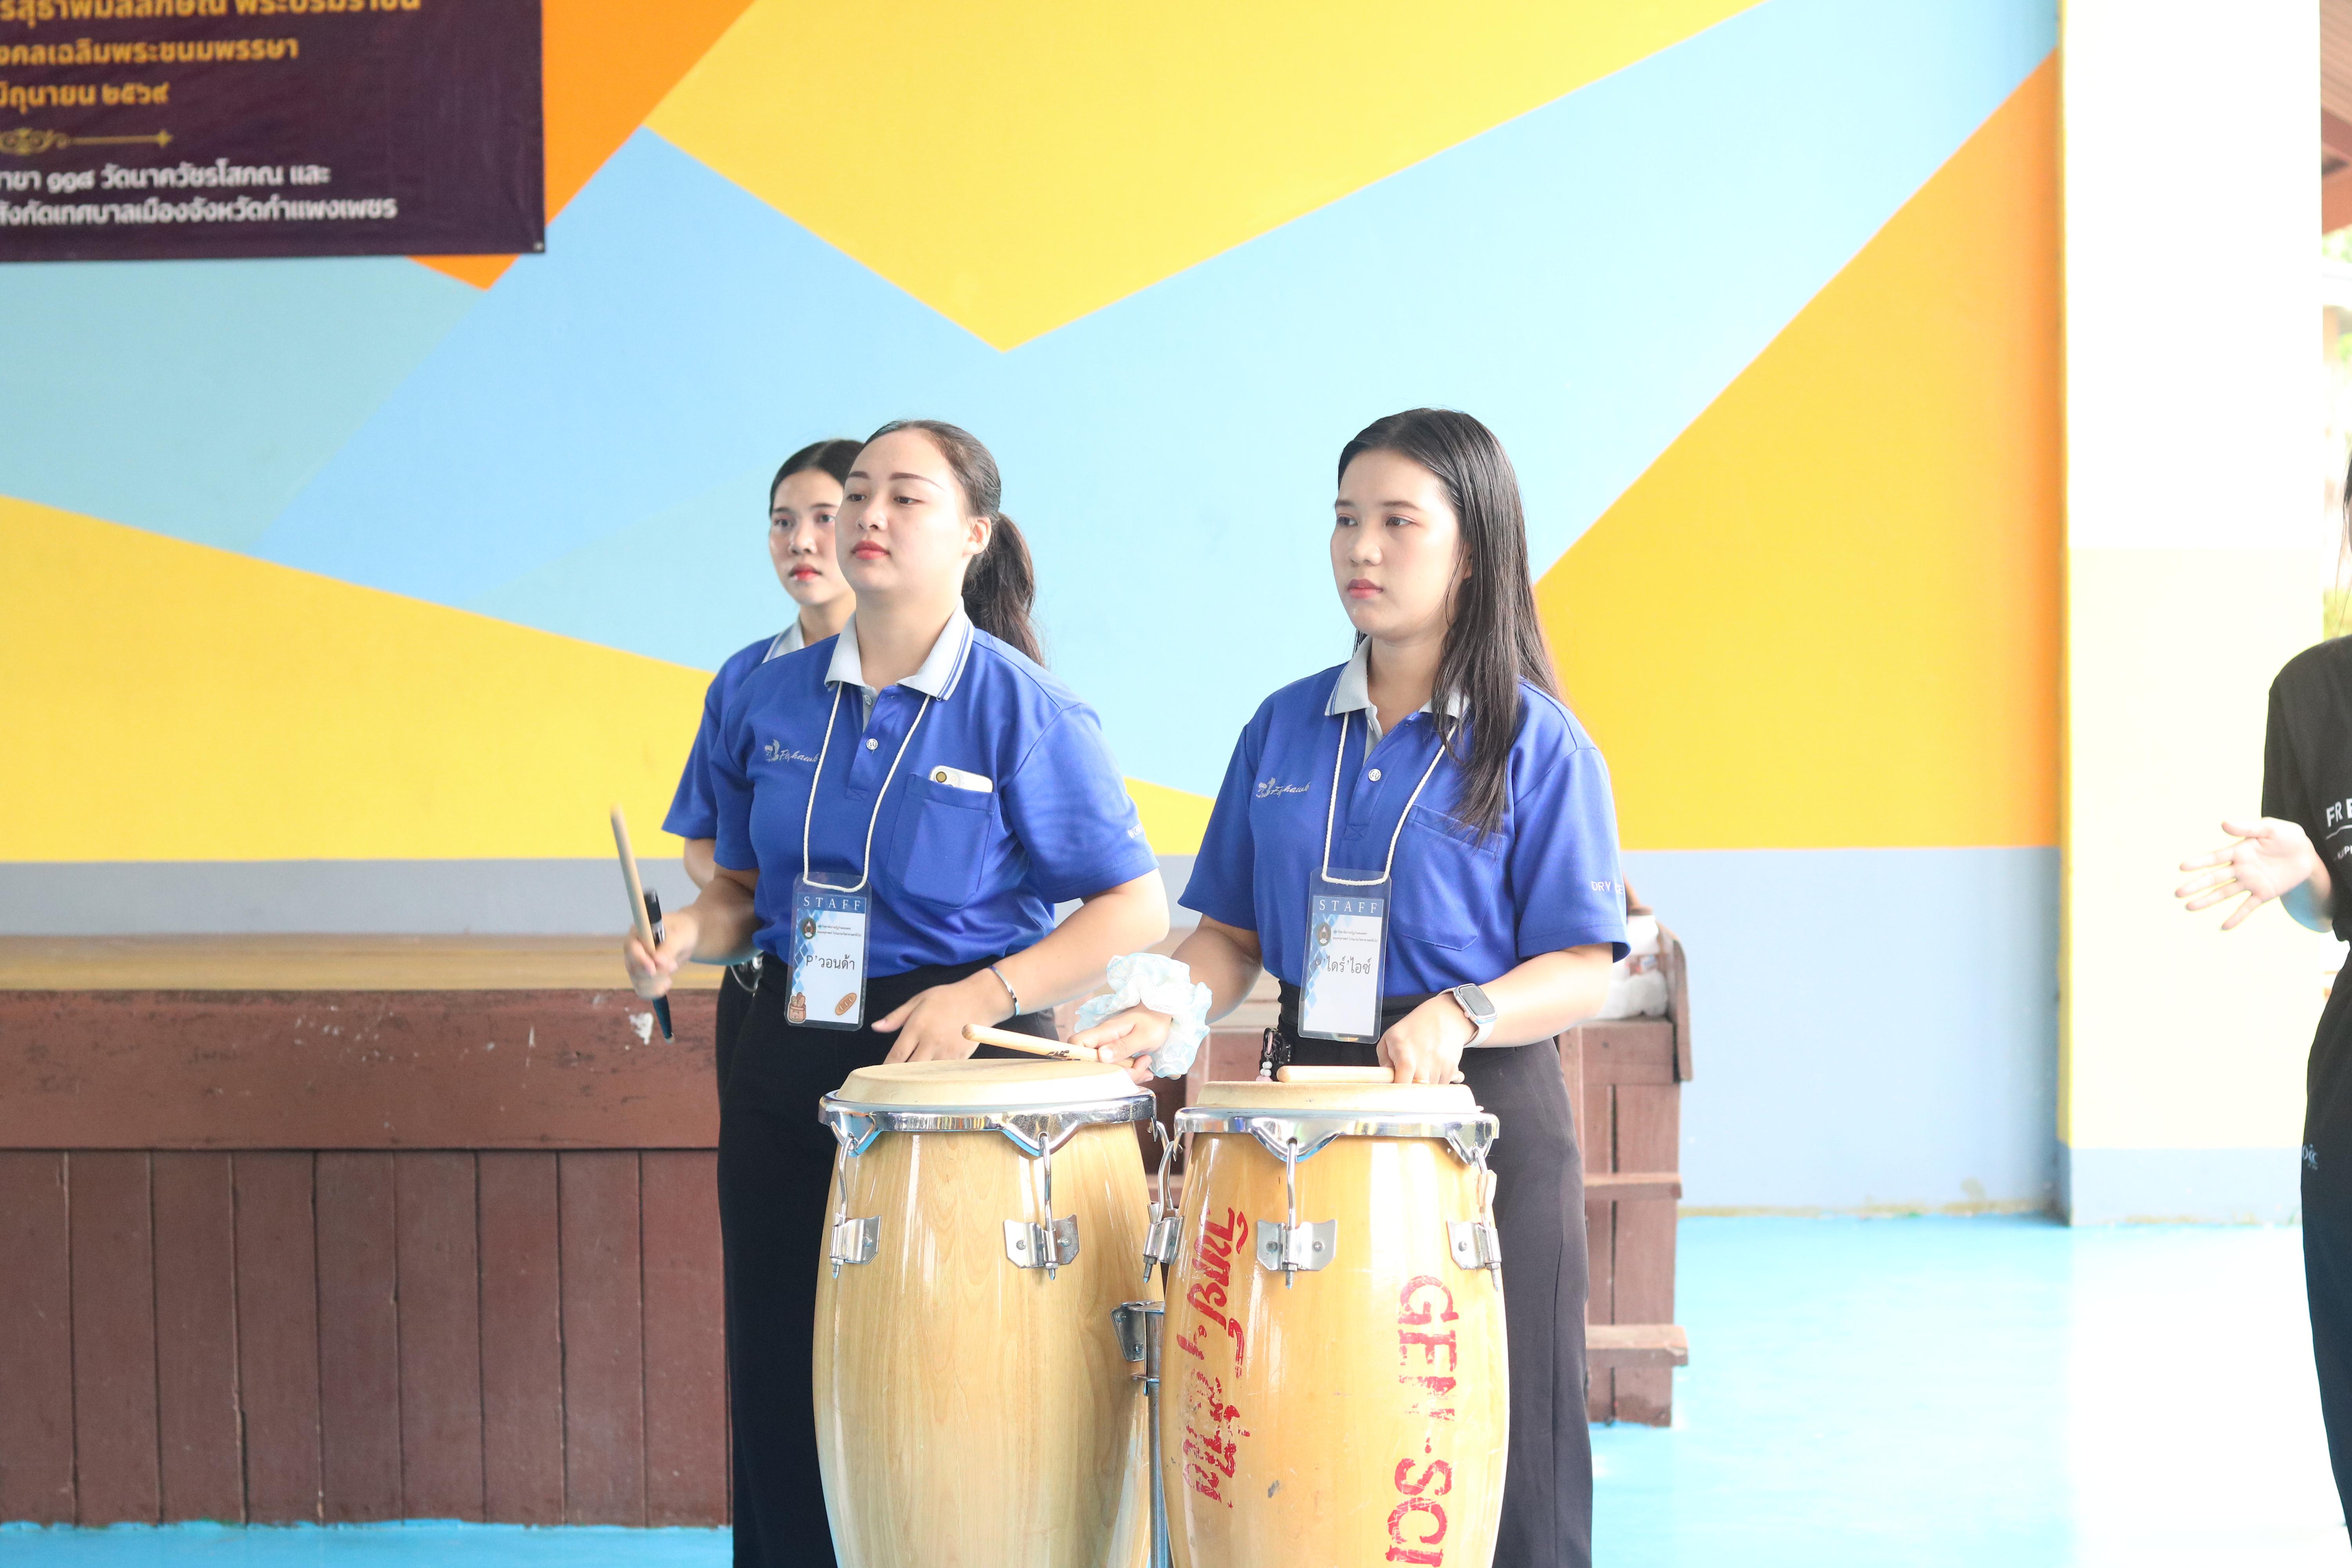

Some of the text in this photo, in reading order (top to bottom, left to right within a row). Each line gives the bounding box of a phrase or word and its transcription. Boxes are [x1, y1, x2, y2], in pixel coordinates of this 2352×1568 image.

[290, 165, 331, 185] และ
[1592, 881, 1611, 891] DRY
[804, 896, 860, 910] STAFF
[1319, 899, 1377, 913] STAFF
